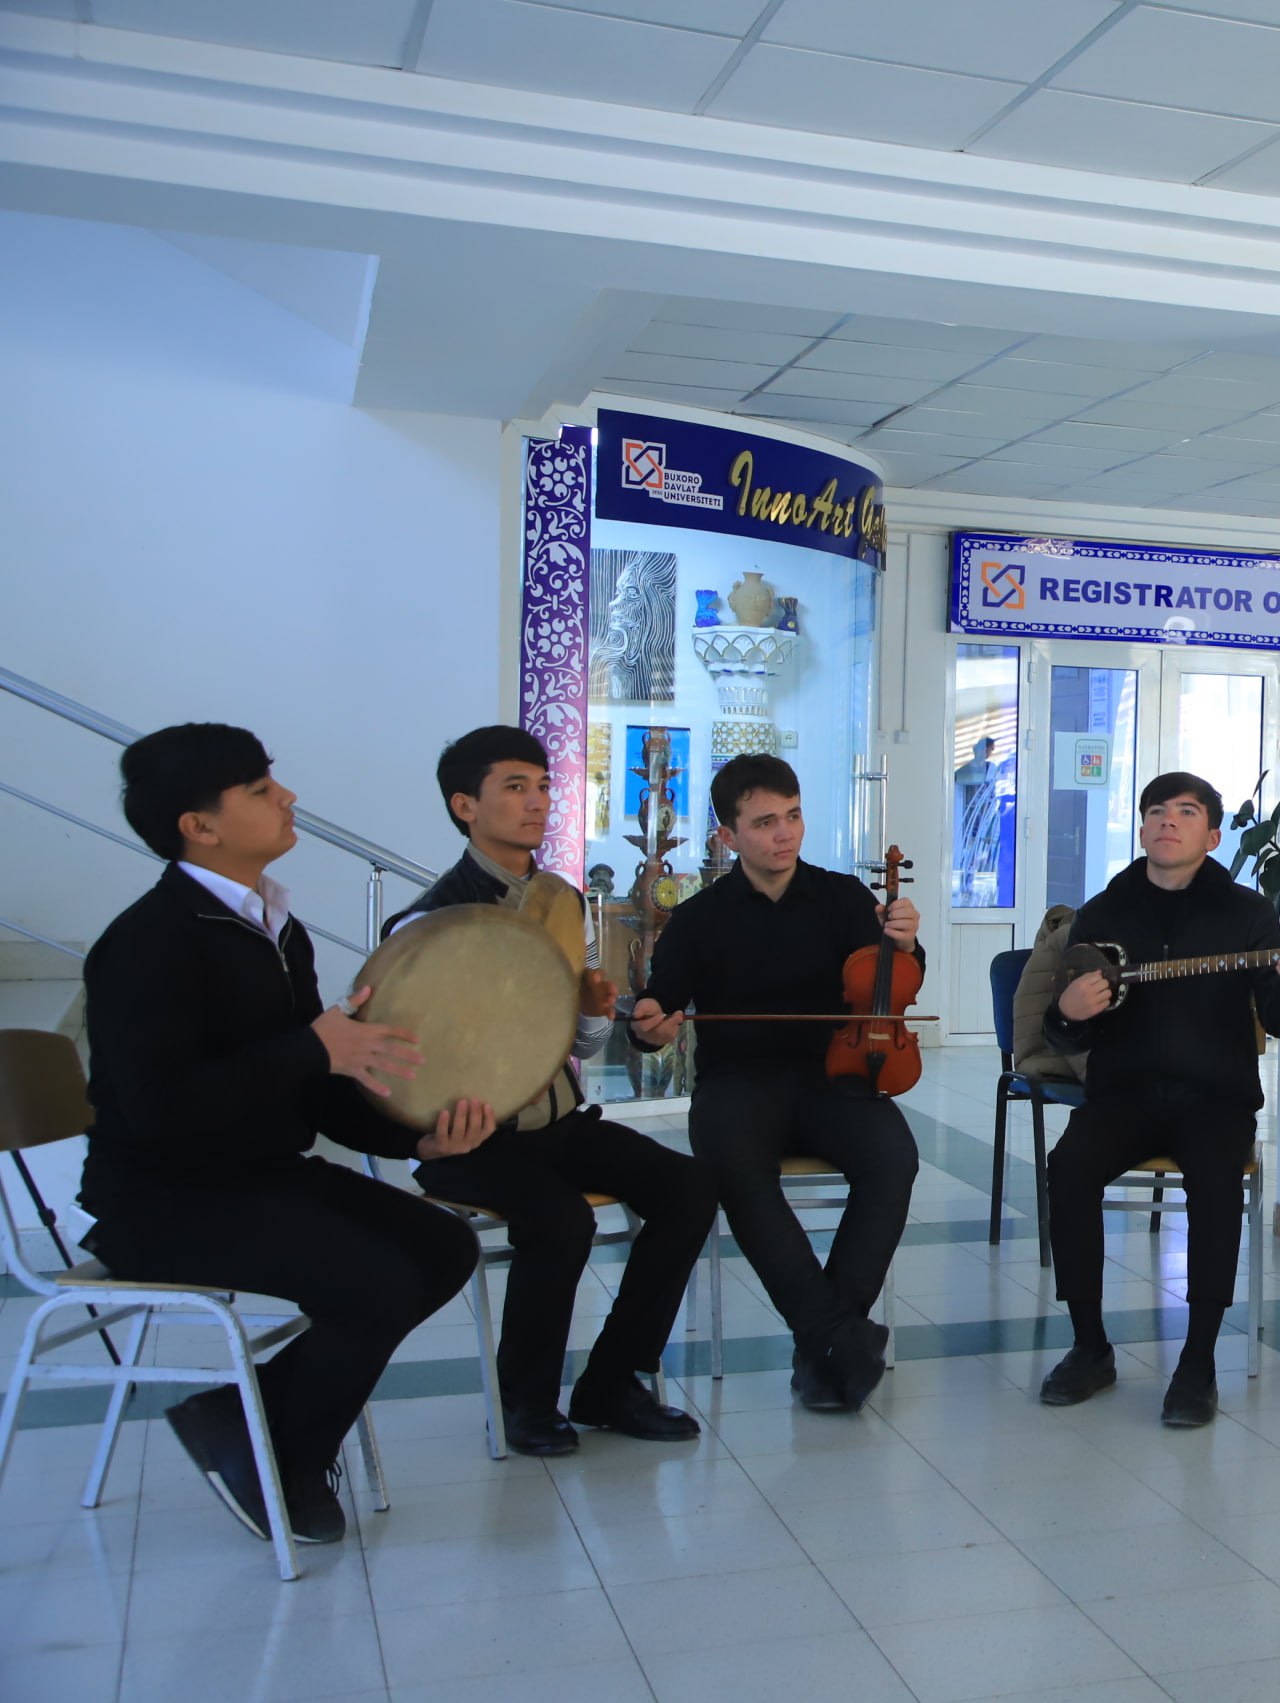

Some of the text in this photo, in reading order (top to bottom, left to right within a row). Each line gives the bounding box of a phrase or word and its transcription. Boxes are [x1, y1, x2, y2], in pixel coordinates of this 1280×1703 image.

[664, 472, 700, 485] BUXORO
[664, 482, 697, 493] DAVLAT
[664, 491, 721, 507] UNIVERSITETI
[1040, 577, 1253, 613] REGISTRATOR
